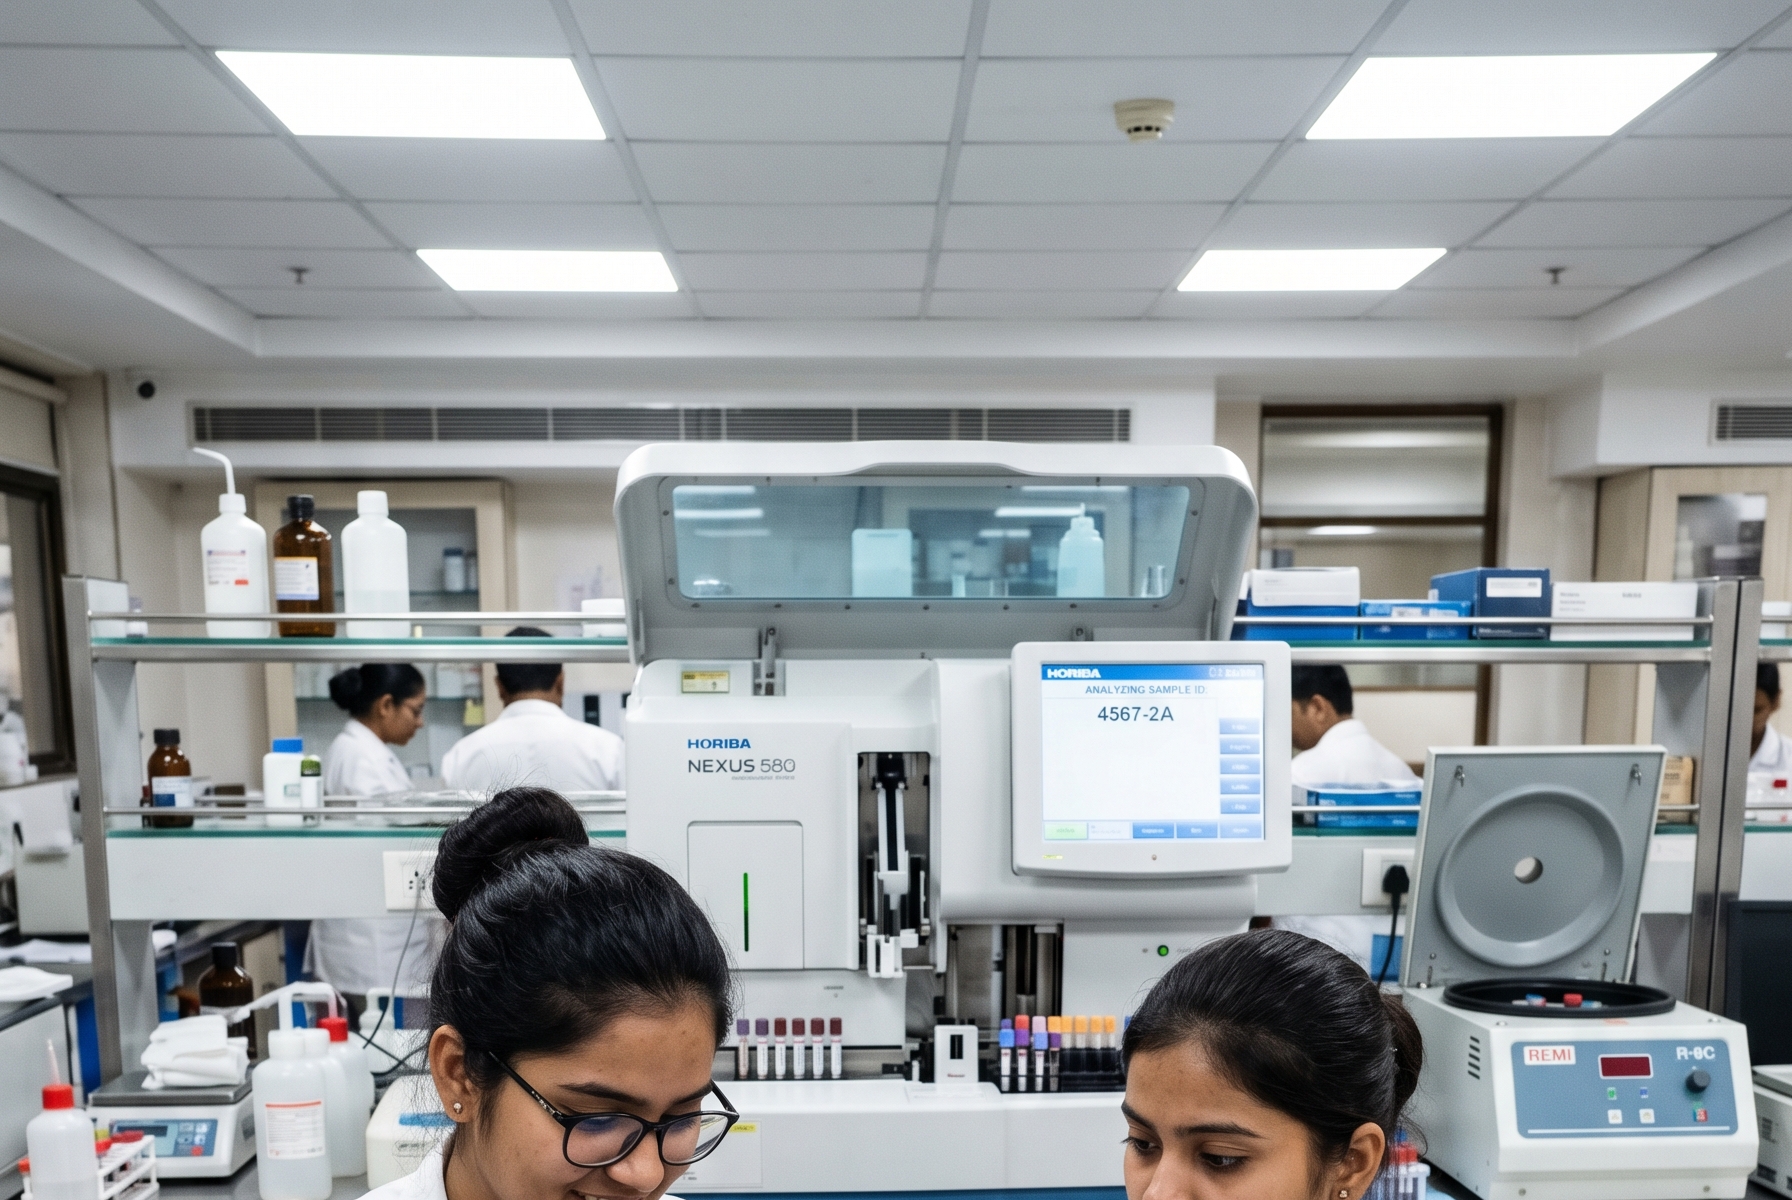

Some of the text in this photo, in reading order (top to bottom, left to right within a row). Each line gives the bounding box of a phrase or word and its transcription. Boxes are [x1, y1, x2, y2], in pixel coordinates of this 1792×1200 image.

[1047, 668, 1101, 679] HORIBA
[1085, 685, 1146, 694] ANALYZING
[1148, 685, 1191, 694] SAMPLE
[1097, 706, 1174, 721] 4567-2A
[687, 738, 751, 749] HORIBA
[688, 758, 796, 773] NEXUS 580
[1528, 1048, 1572, 1062] REMI
